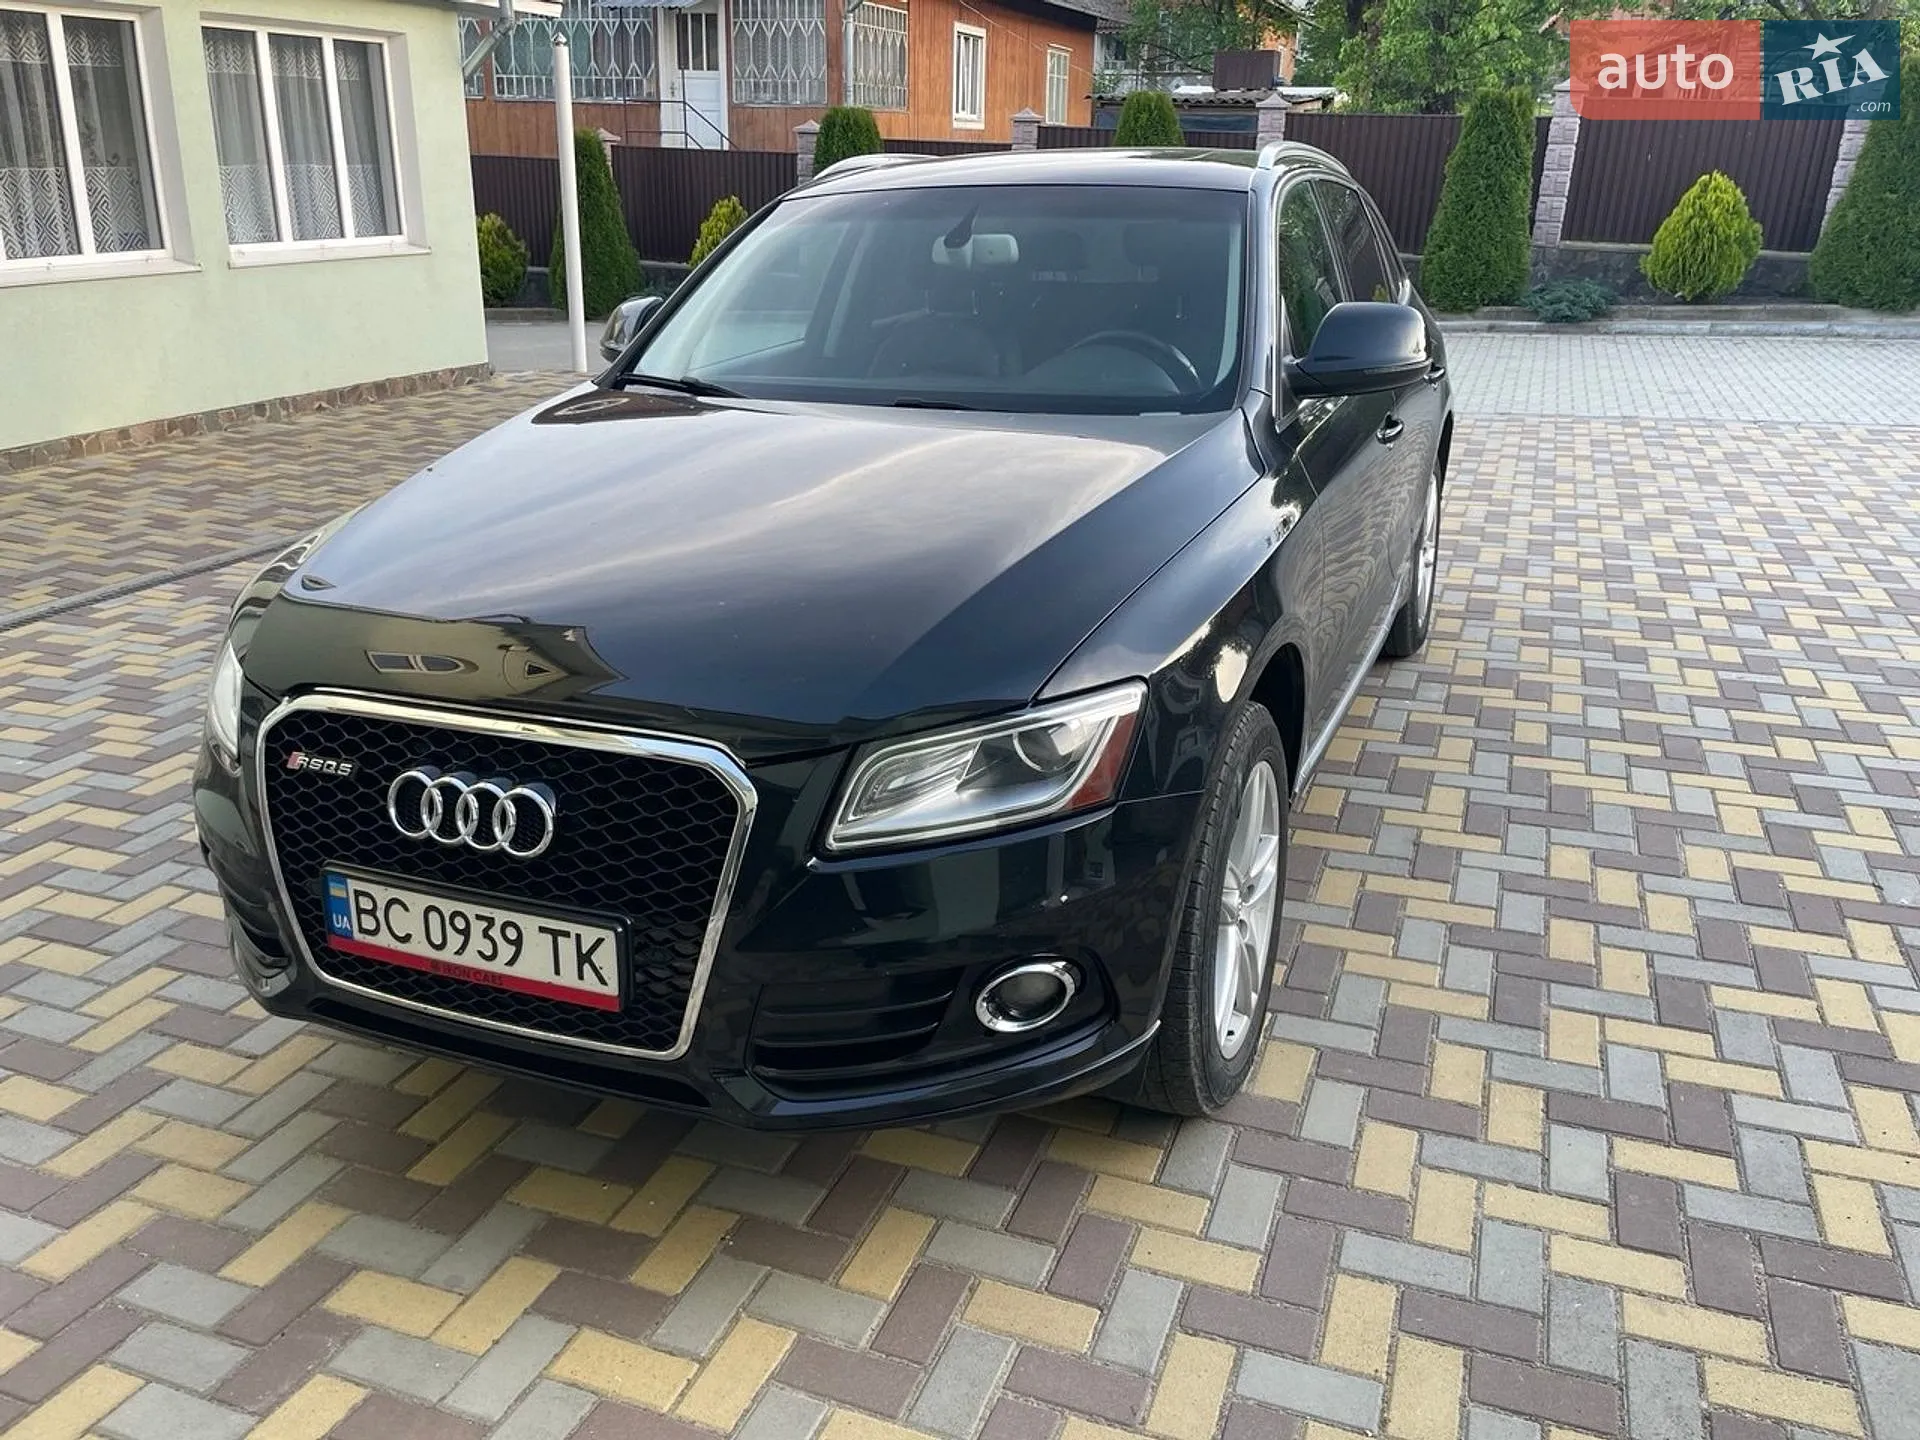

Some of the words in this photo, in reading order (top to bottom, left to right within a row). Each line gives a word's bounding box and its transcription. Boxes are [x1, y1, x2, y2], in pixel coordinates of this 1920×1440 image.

[333, 913, 351, 930] UA
[353, 888, 413, 944] BC
[423, 905, 524, 967] 0939
[538, 925, 609, 987] TK
